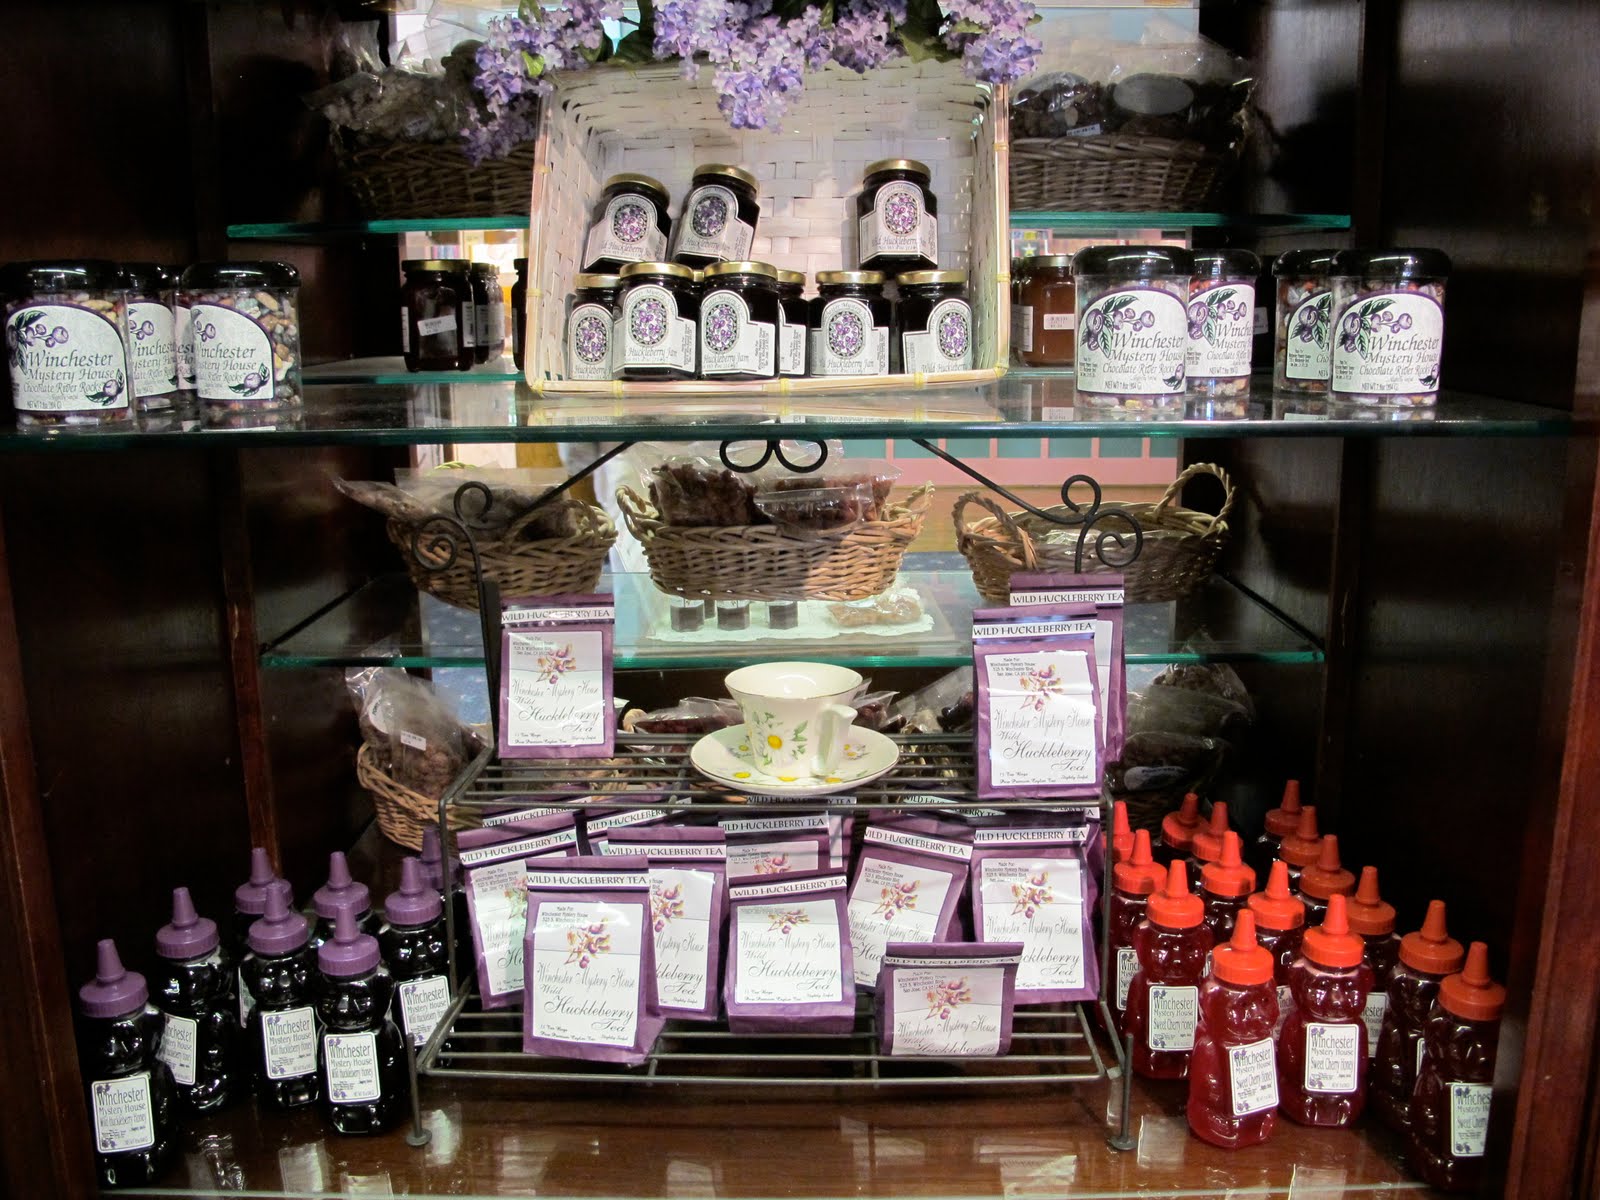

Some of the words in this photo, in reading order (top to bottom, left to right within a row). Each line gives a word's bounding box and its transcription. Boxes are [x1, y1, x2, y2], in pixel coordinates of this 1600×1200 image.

[1113, 331, 1184, 349] Winchester
[1368, 334, 1439, 351] Winchester
[201, 342, 256, 359] inchester
[26, 349, 114, 368] Winchester
[132, 356, 160, 370] ystery
[1109, 350, 1156, 366] Mystery
[1366, 352, 1412, 368] Mystery
[223, 360, 256, 372] House
[1102, 362, 1137, 373] Chocolate
[1359, 364, 1394, 376] Chocolate
[27, 368, 75, 384] Mystery
[79, 368, 114, 381] House
[24, 382, 54, 393] Chocolate
[1012, 594, 1036, 604] WILD
[1038, 592, 1104, 604] HUCKLEBERRY
[1107, 592, 1124, 602] TEA
[501, 612, 525, 622] WILD
[593, 609, 610, 617] TEA
[973, 624, 998, 636] WILD
[1001, 623, 1072, 635] HUCKLEBERRY
[1074, 622, 1092, 632] TEA
[998, 730, 1021, 741] Wild
[1002, 739, 1092, 765] Huckleberry
[1050, 758, 1086, 773] Tea
[740, 820, 804, 830] HUCKLEBERRY
[996, 830, 1064, 840] HUCKLEBERRY
[1068, 830, 1086, 838] TEA
[484, 838, 552, 858] HUCKLEBERRY
[554, 833, 572, 843] TEA
[608, 848, 632, 856] WILD
[634, 848, 702, 856] HUCKLEBERRY
[705, 848, 723, 856] TEA
[884, 834, 946, 852] HUCKLEBERRY
[948, 845, 965, 856] TEA
[527, 875, 551, 884] WILD
[554, 876, 628, 884] HUCKLEBERRY
[628, 876, 646, 884] TEA
[734, 887, 758, 896] WILD
[760, 882, 828, 894] HUCKLEBERRY
[829, 878, 846, 886] TEA
[1022, 946, 1080, 969] ckleberry
[748, 960, 838, 983] Huckleberry
[1040, 964, 1074, 976] Tea
[540, 984, 562, 994] Wild
[664, 982, 696, 996] Tea
[796, 978, 830, 990] Tea
[1154, 996, 1194, 1010] Winchester
[544, 996, 634, 1026] Huckleberry
[268, 1018, 310, 1036] Winchester
[590, 1018, 626, 1032] Tea
[1311, 1035, 1354, 1048] Winchester
[329, 1044, 370, 1058] Winchester
[1234, 1048, 1271, 1068] Winchester
[96, 1088, 144, 1106] Winchester
